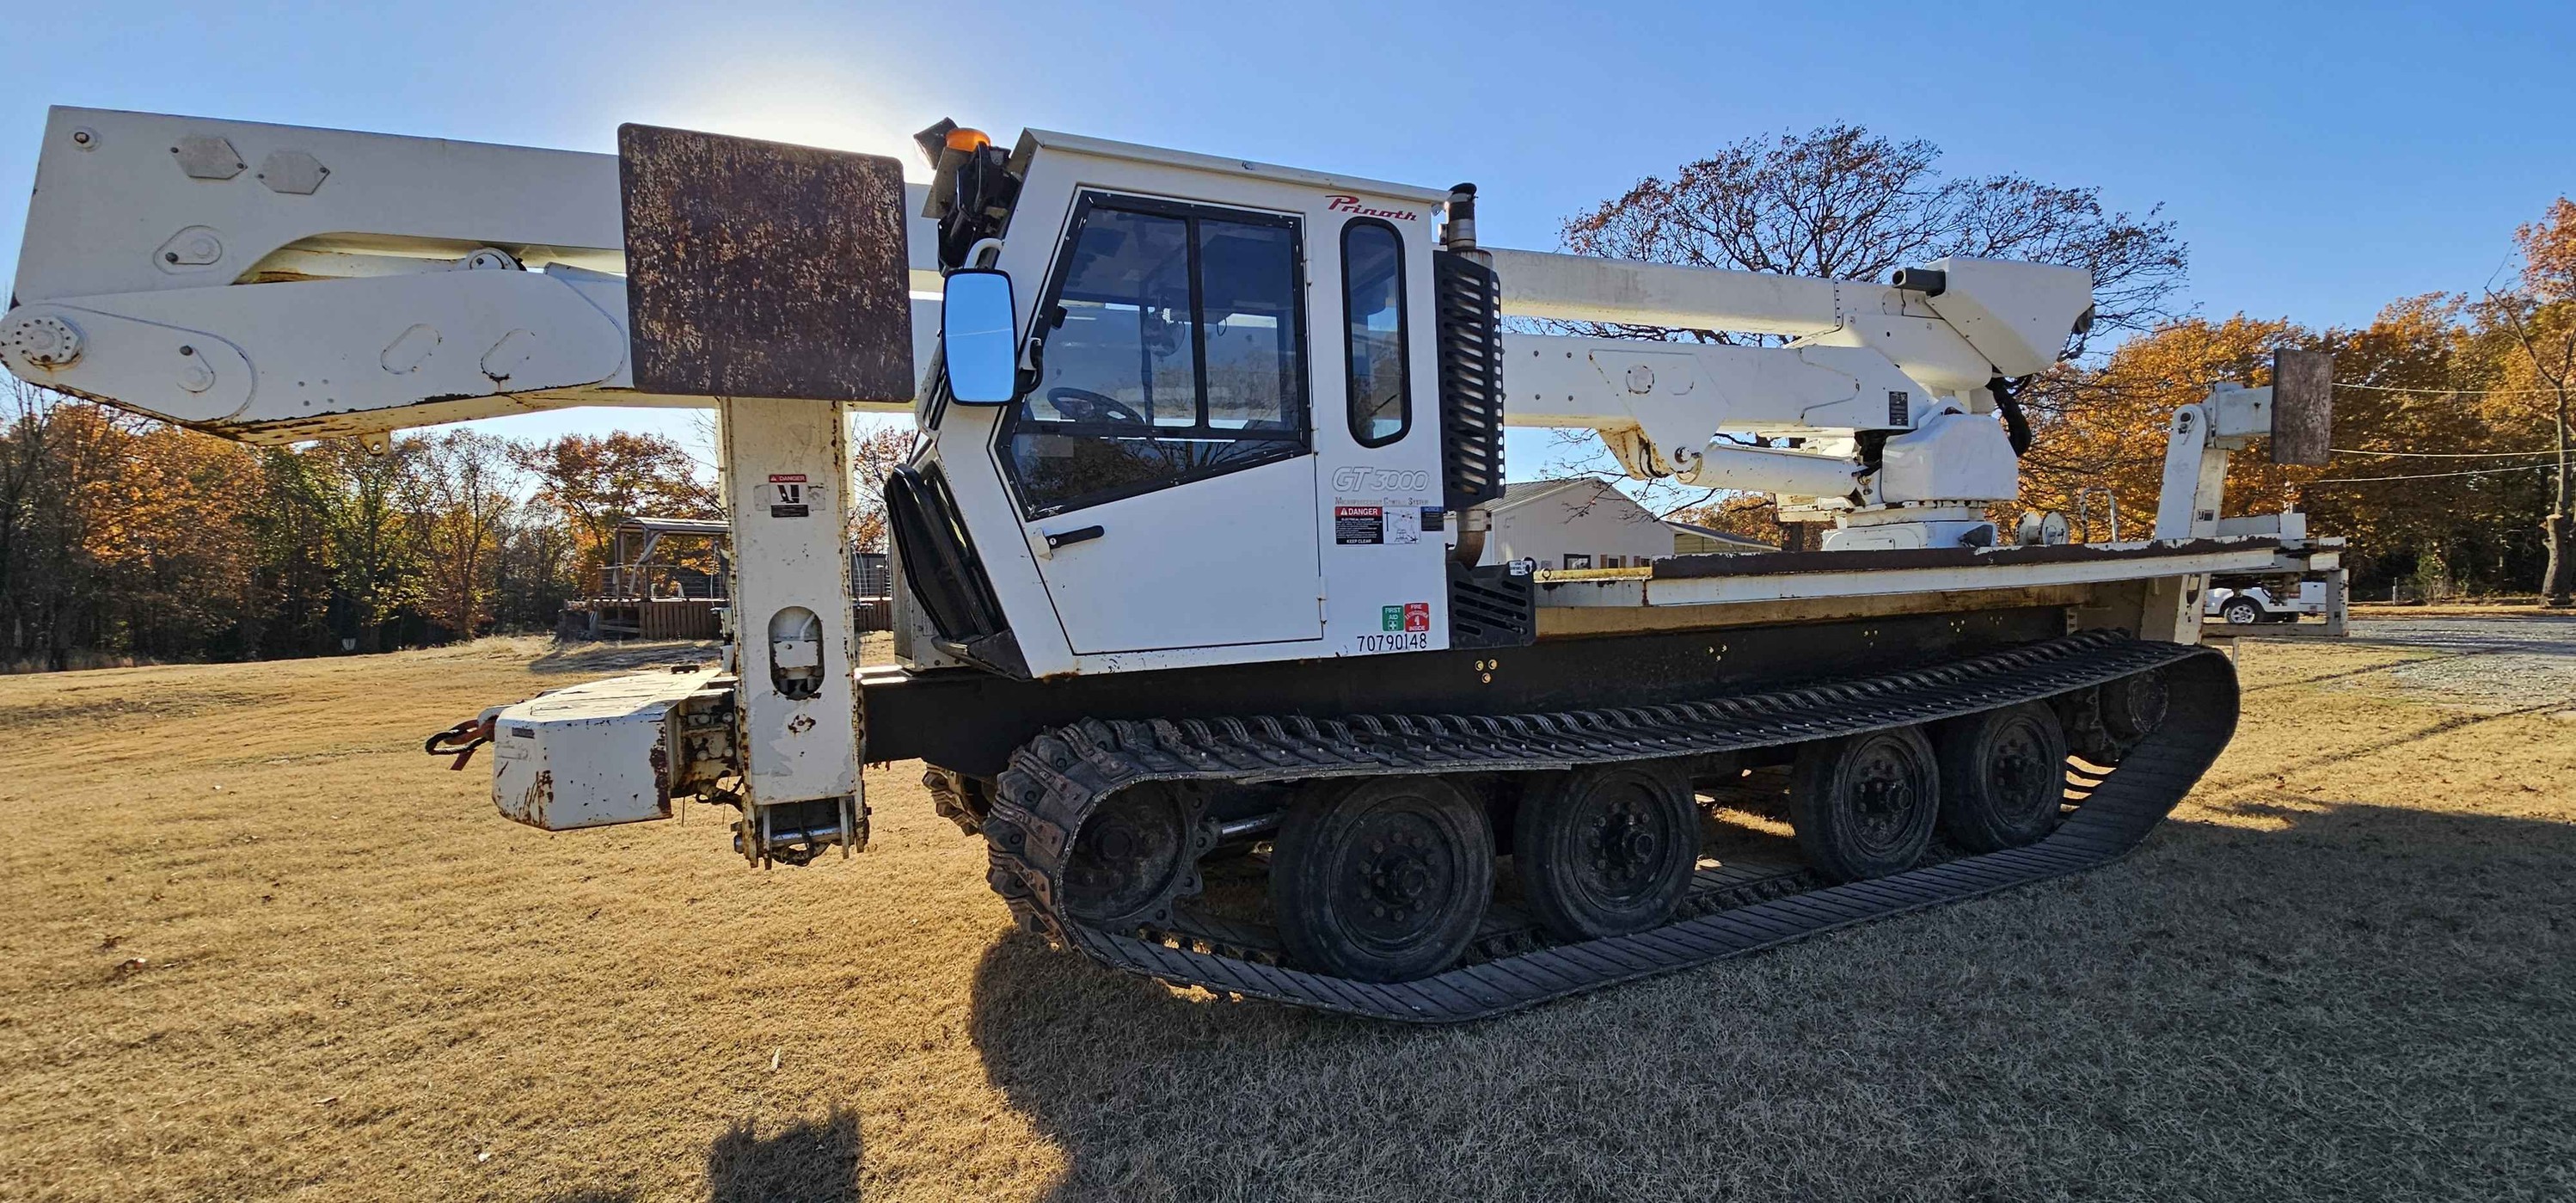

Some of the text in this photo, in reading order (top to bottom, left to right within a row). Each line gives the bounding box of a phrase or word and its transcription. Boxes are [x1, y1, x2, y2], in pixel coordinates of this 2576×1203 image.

[1325, 195, 1416, 221] Prinoth
[1332, 466, 1429, 492] GT 3000
[1348, 507, 1378, 516] DANGER
[1357, 632, 1427, 652] 70790148
